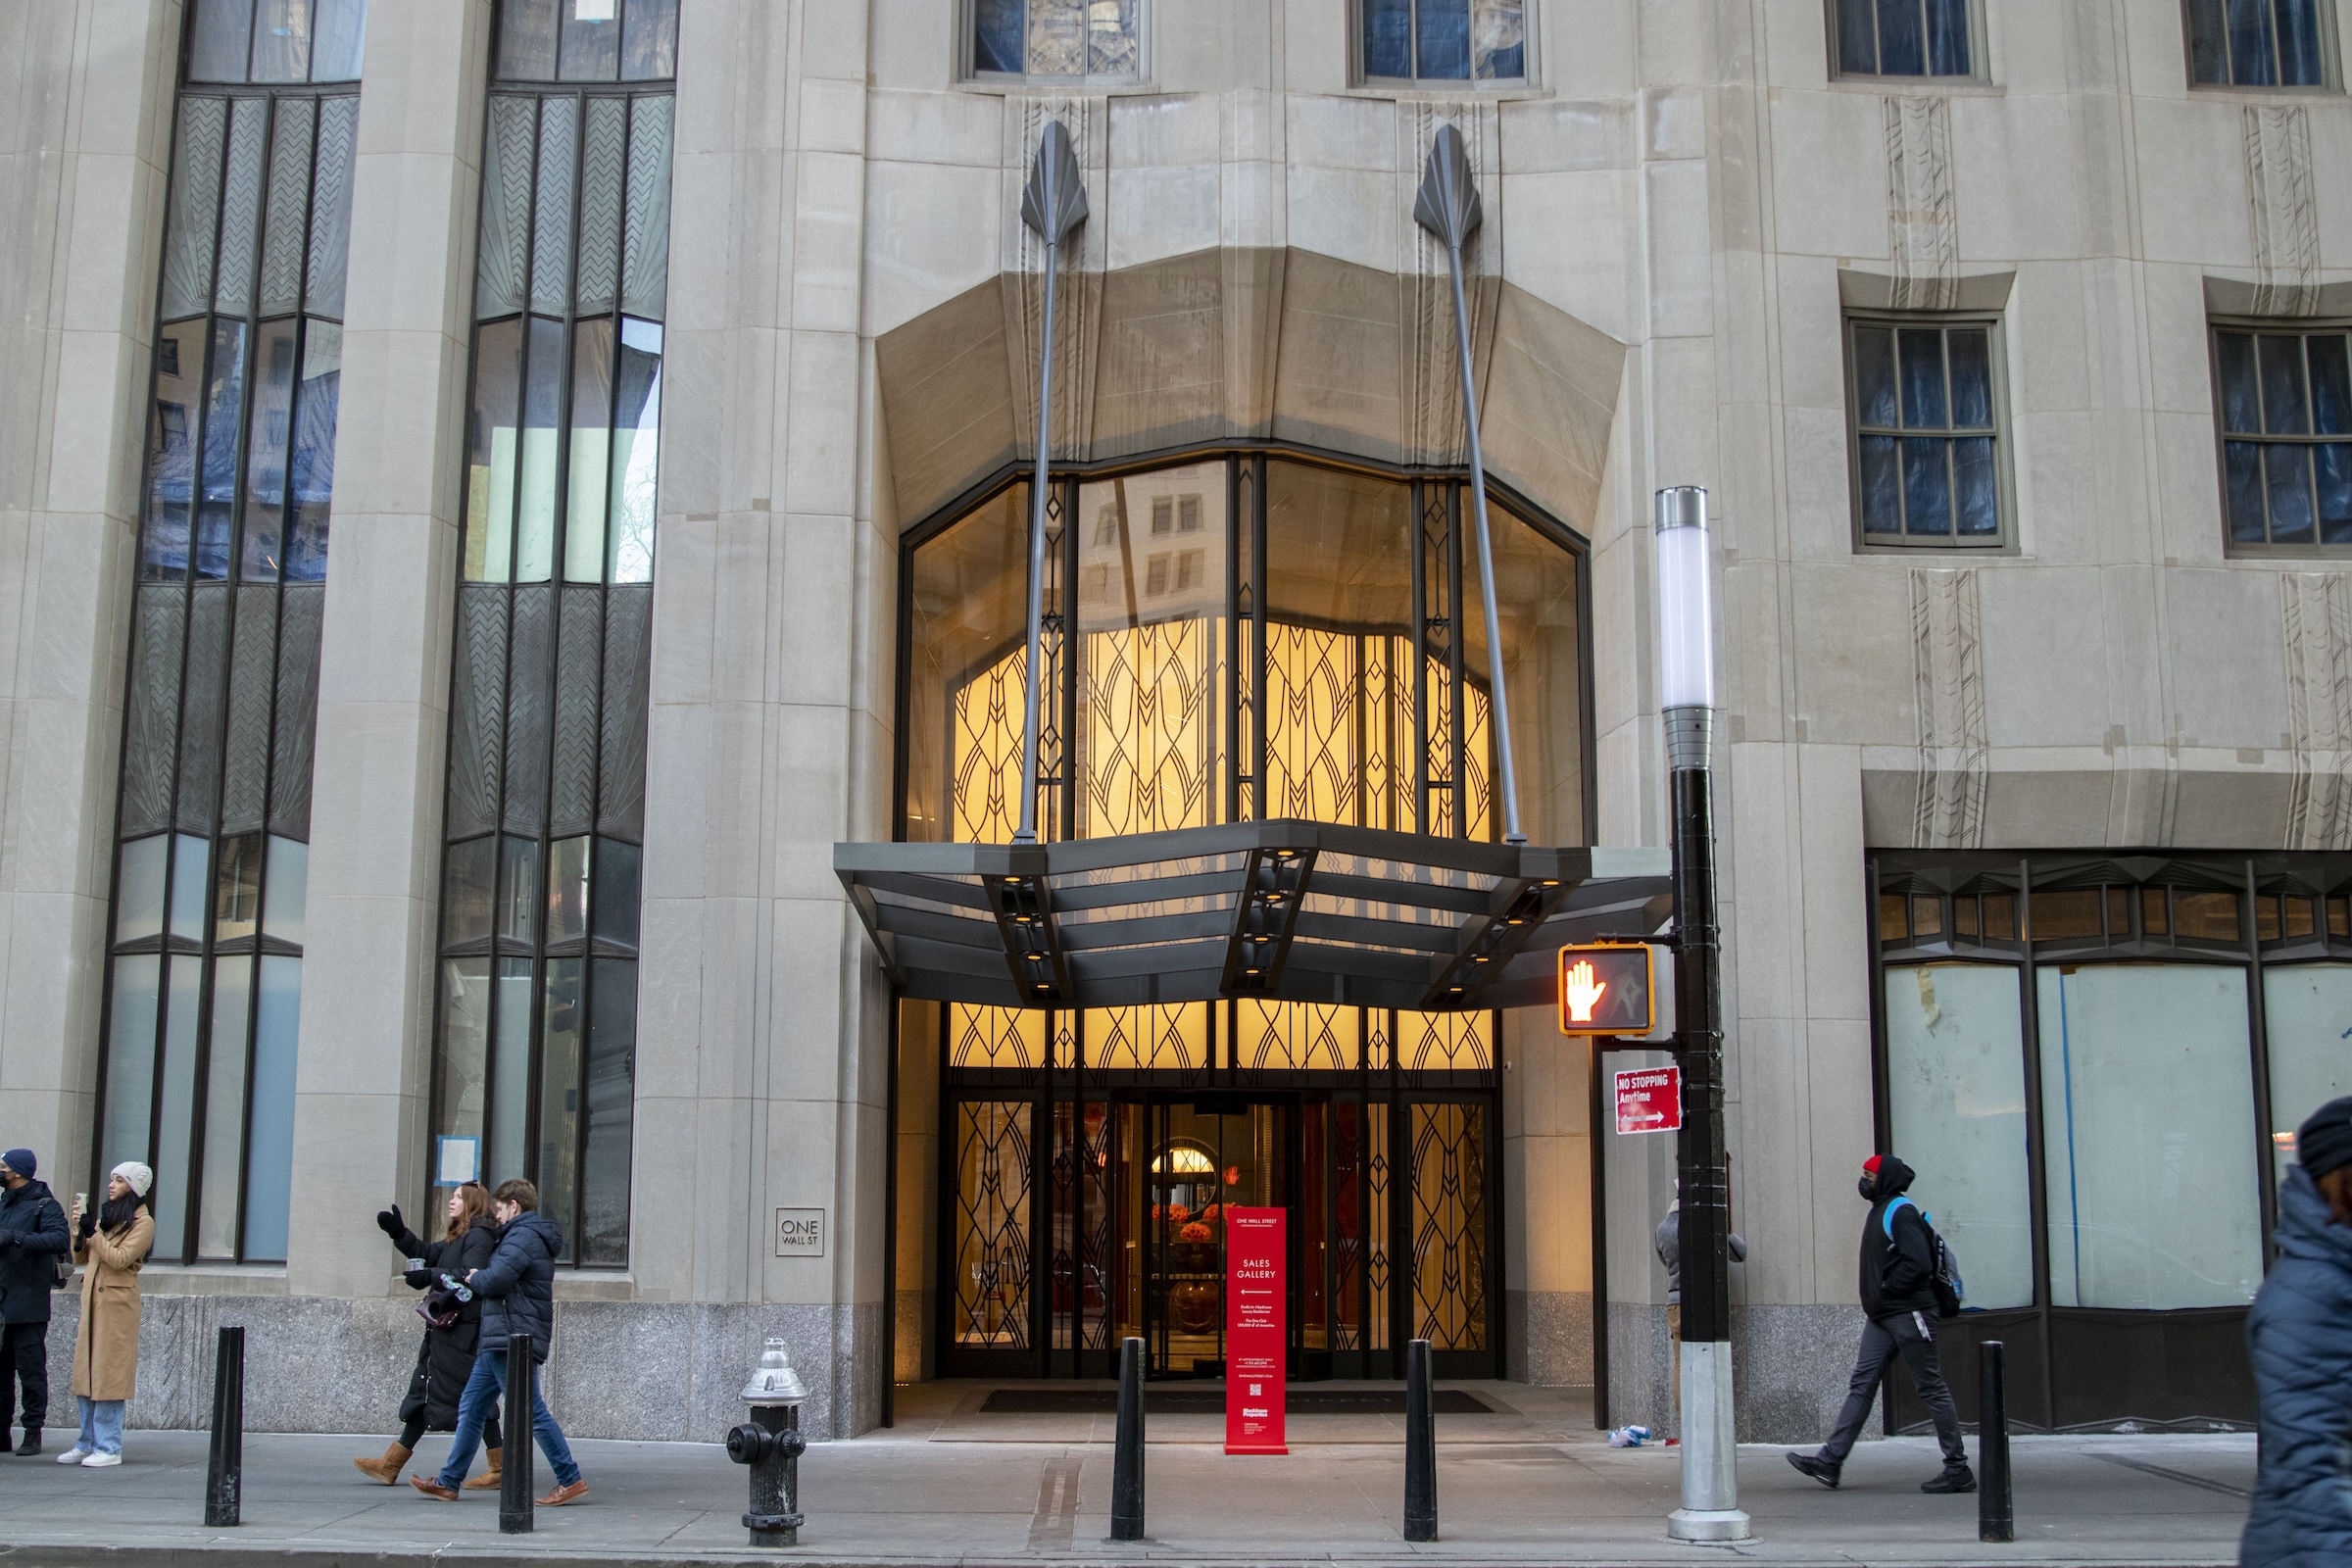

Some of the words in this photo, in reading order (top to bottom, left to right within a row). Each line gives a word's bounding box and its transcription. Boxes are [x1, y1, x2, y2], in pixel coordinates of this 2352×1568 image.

[1619, 1078, 1630, 1090] NO
[1631, 1074, 1668, 1089] STOPPING
[1620, 1091, 1651, 1104] Anytime
[781, 1220, 817, 1234] ONE
[782, 1236, 805, 1245] WALL
[808, 1236, 817, 1245] ST
[1243, 1258, 1270, 1268] SALES
[1237, 1270, 1276, 1279] GALLERY
